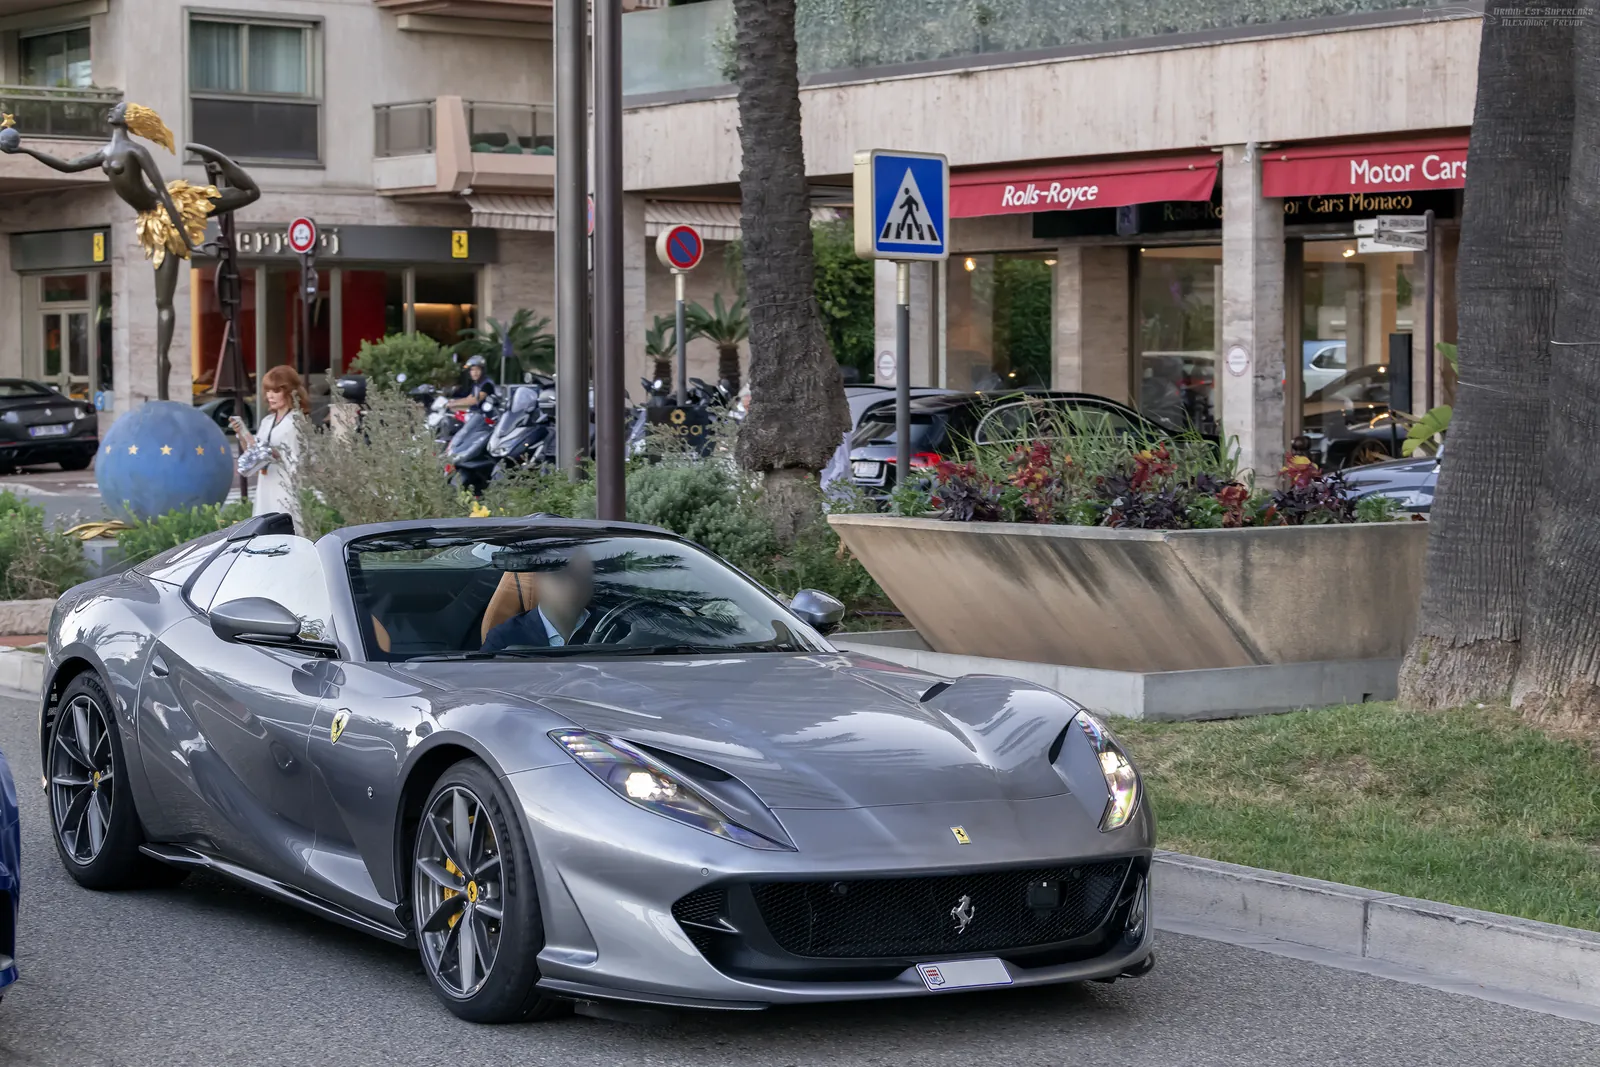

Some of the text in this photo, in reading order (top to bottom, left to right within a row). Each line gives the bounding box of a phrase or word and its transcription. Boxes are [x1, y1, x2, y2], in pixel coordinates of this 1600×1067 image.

[1350, 154, 1467, 185] Motor Cars
[1001, 182, 1098, 209] Rolls-Royce
[1308, 195, 1344, 213] Cars
[1349, 193, 1413, 212] Monaco
